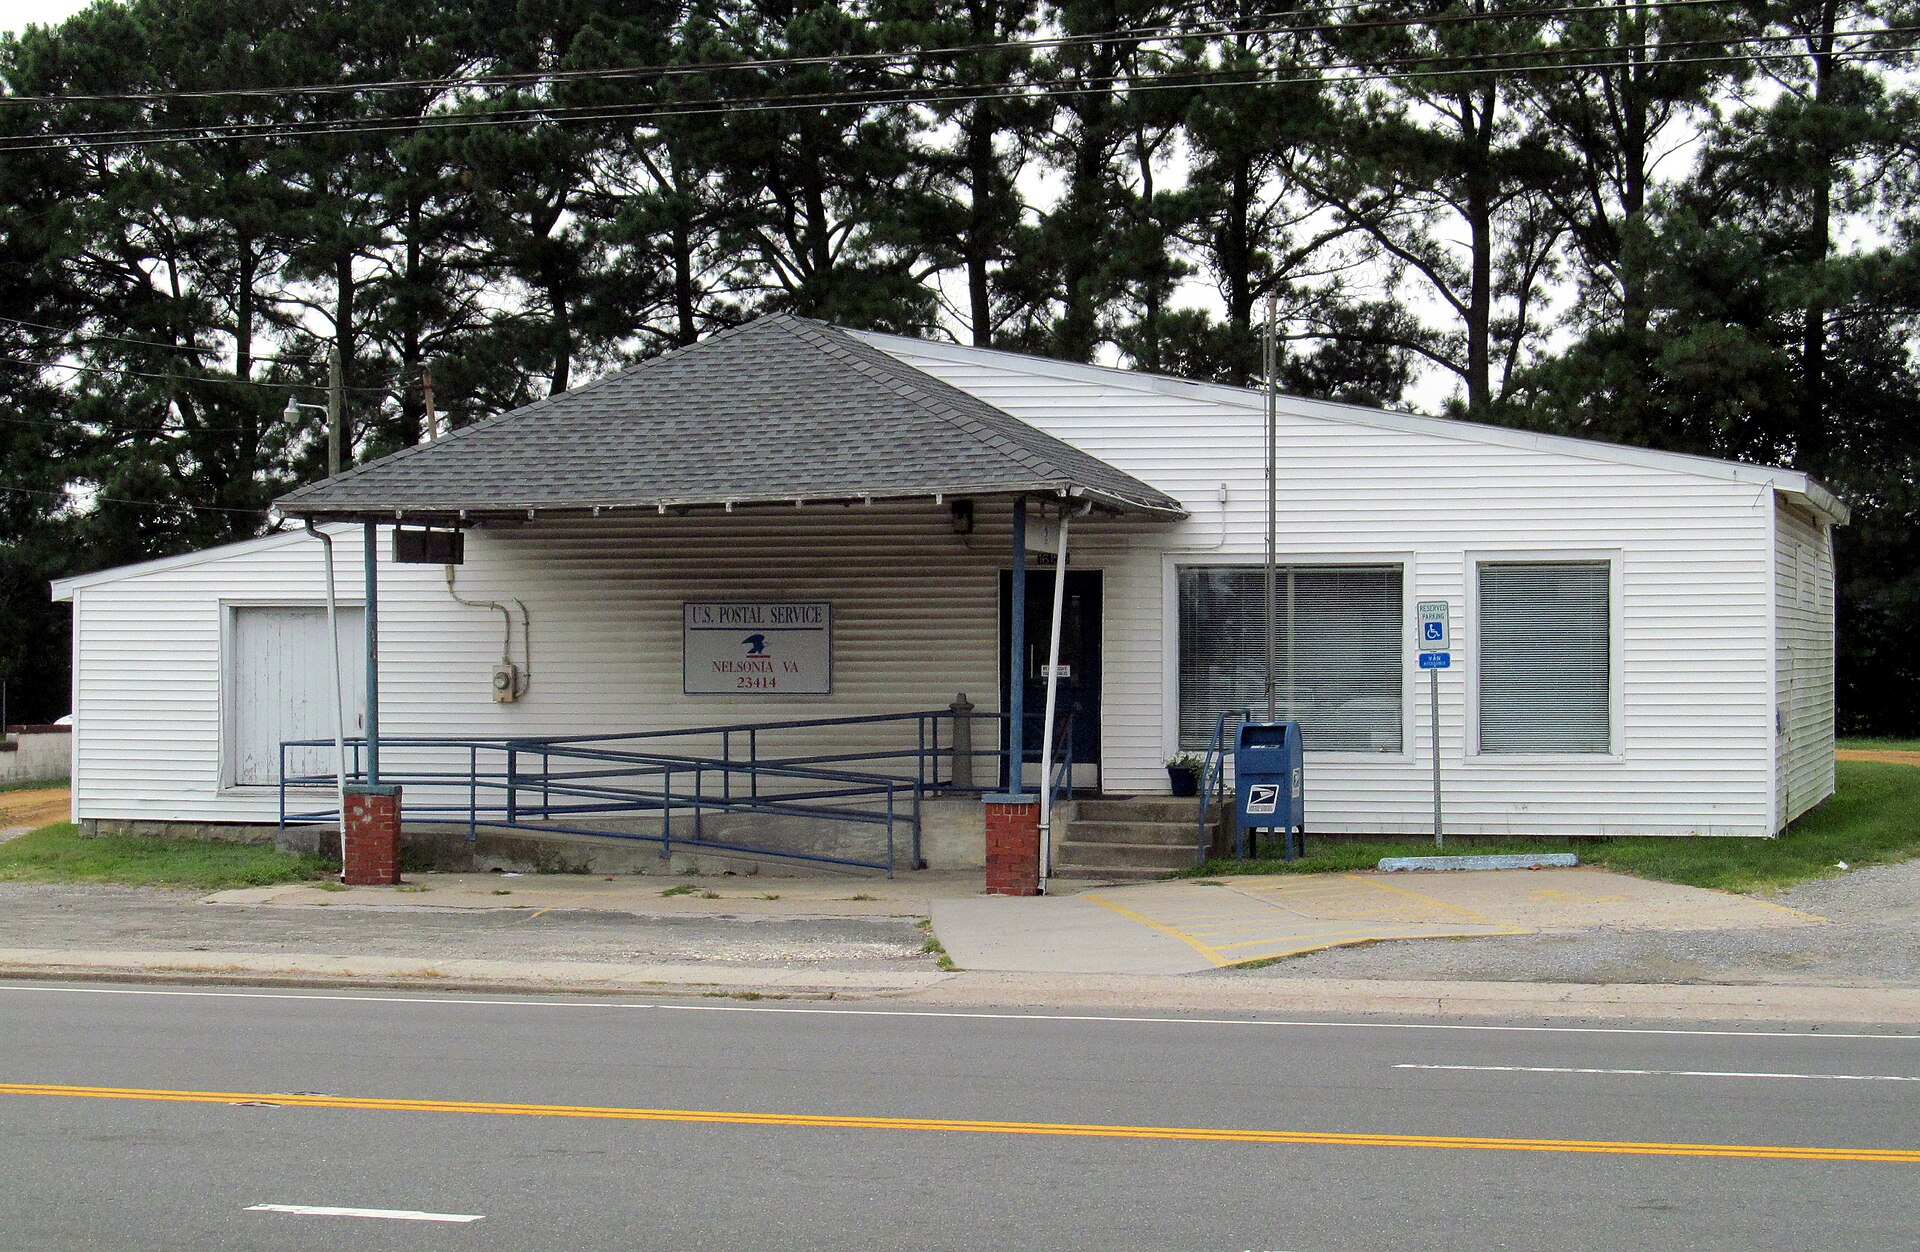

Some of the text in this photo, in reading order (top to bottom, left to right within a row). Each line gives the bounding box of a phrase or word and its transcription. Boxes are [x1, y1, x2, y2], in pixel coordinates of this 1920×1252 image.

[692, 606, 822, 624] U.S. POSTAL SERVICE
[712, 660, 799, 673] NELSONIA VA
[736, 676, 777, 689] 23414
